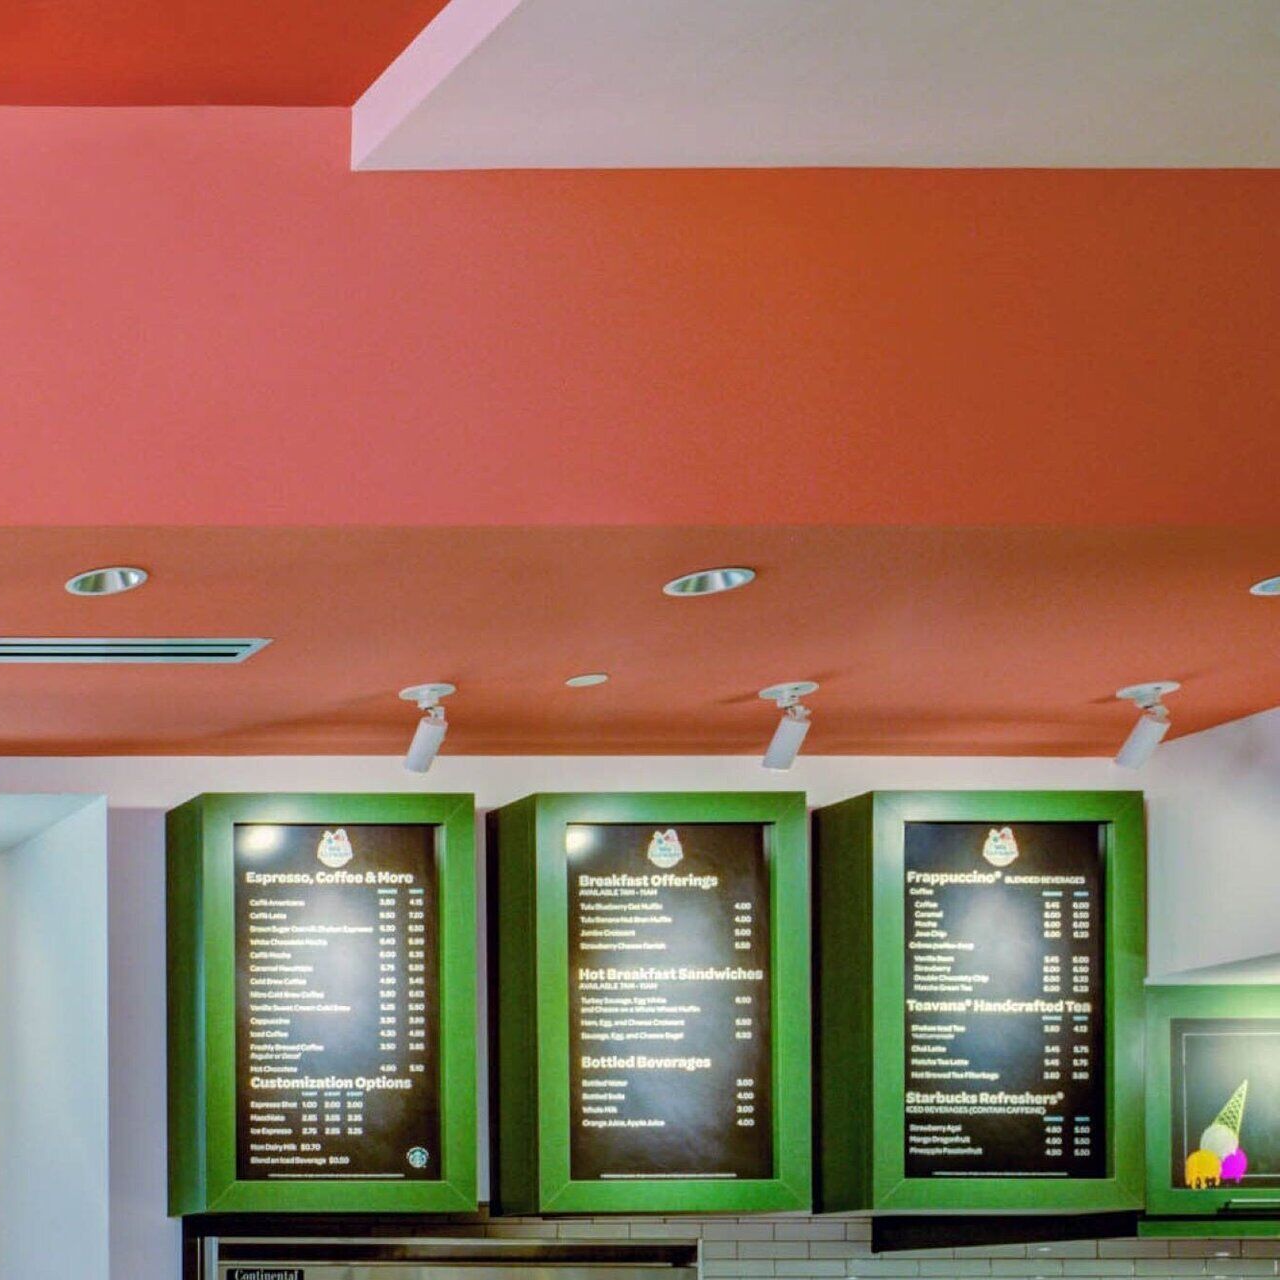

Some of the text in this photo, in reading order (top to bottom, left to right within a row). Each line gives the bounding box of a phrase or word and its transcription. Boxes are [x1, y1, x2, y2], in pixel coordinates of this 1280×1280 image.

[246, 872, 414, 886] Espresso, Coffee & More
[579, 874, 718, 889] Breakfast Offerings
[579, 968, 763, 981] Hot Breakfast Sandwiches
[973, 1000, 1063, 1012] Handcrafted
[1065, 1000, 1091, 1012] Tea
[582, 1056, 712, 1071] Bottled Beverages
[251, 1077, 413, 1090] Customization Options
[906, 1091, 977, 1105] Starbucks
